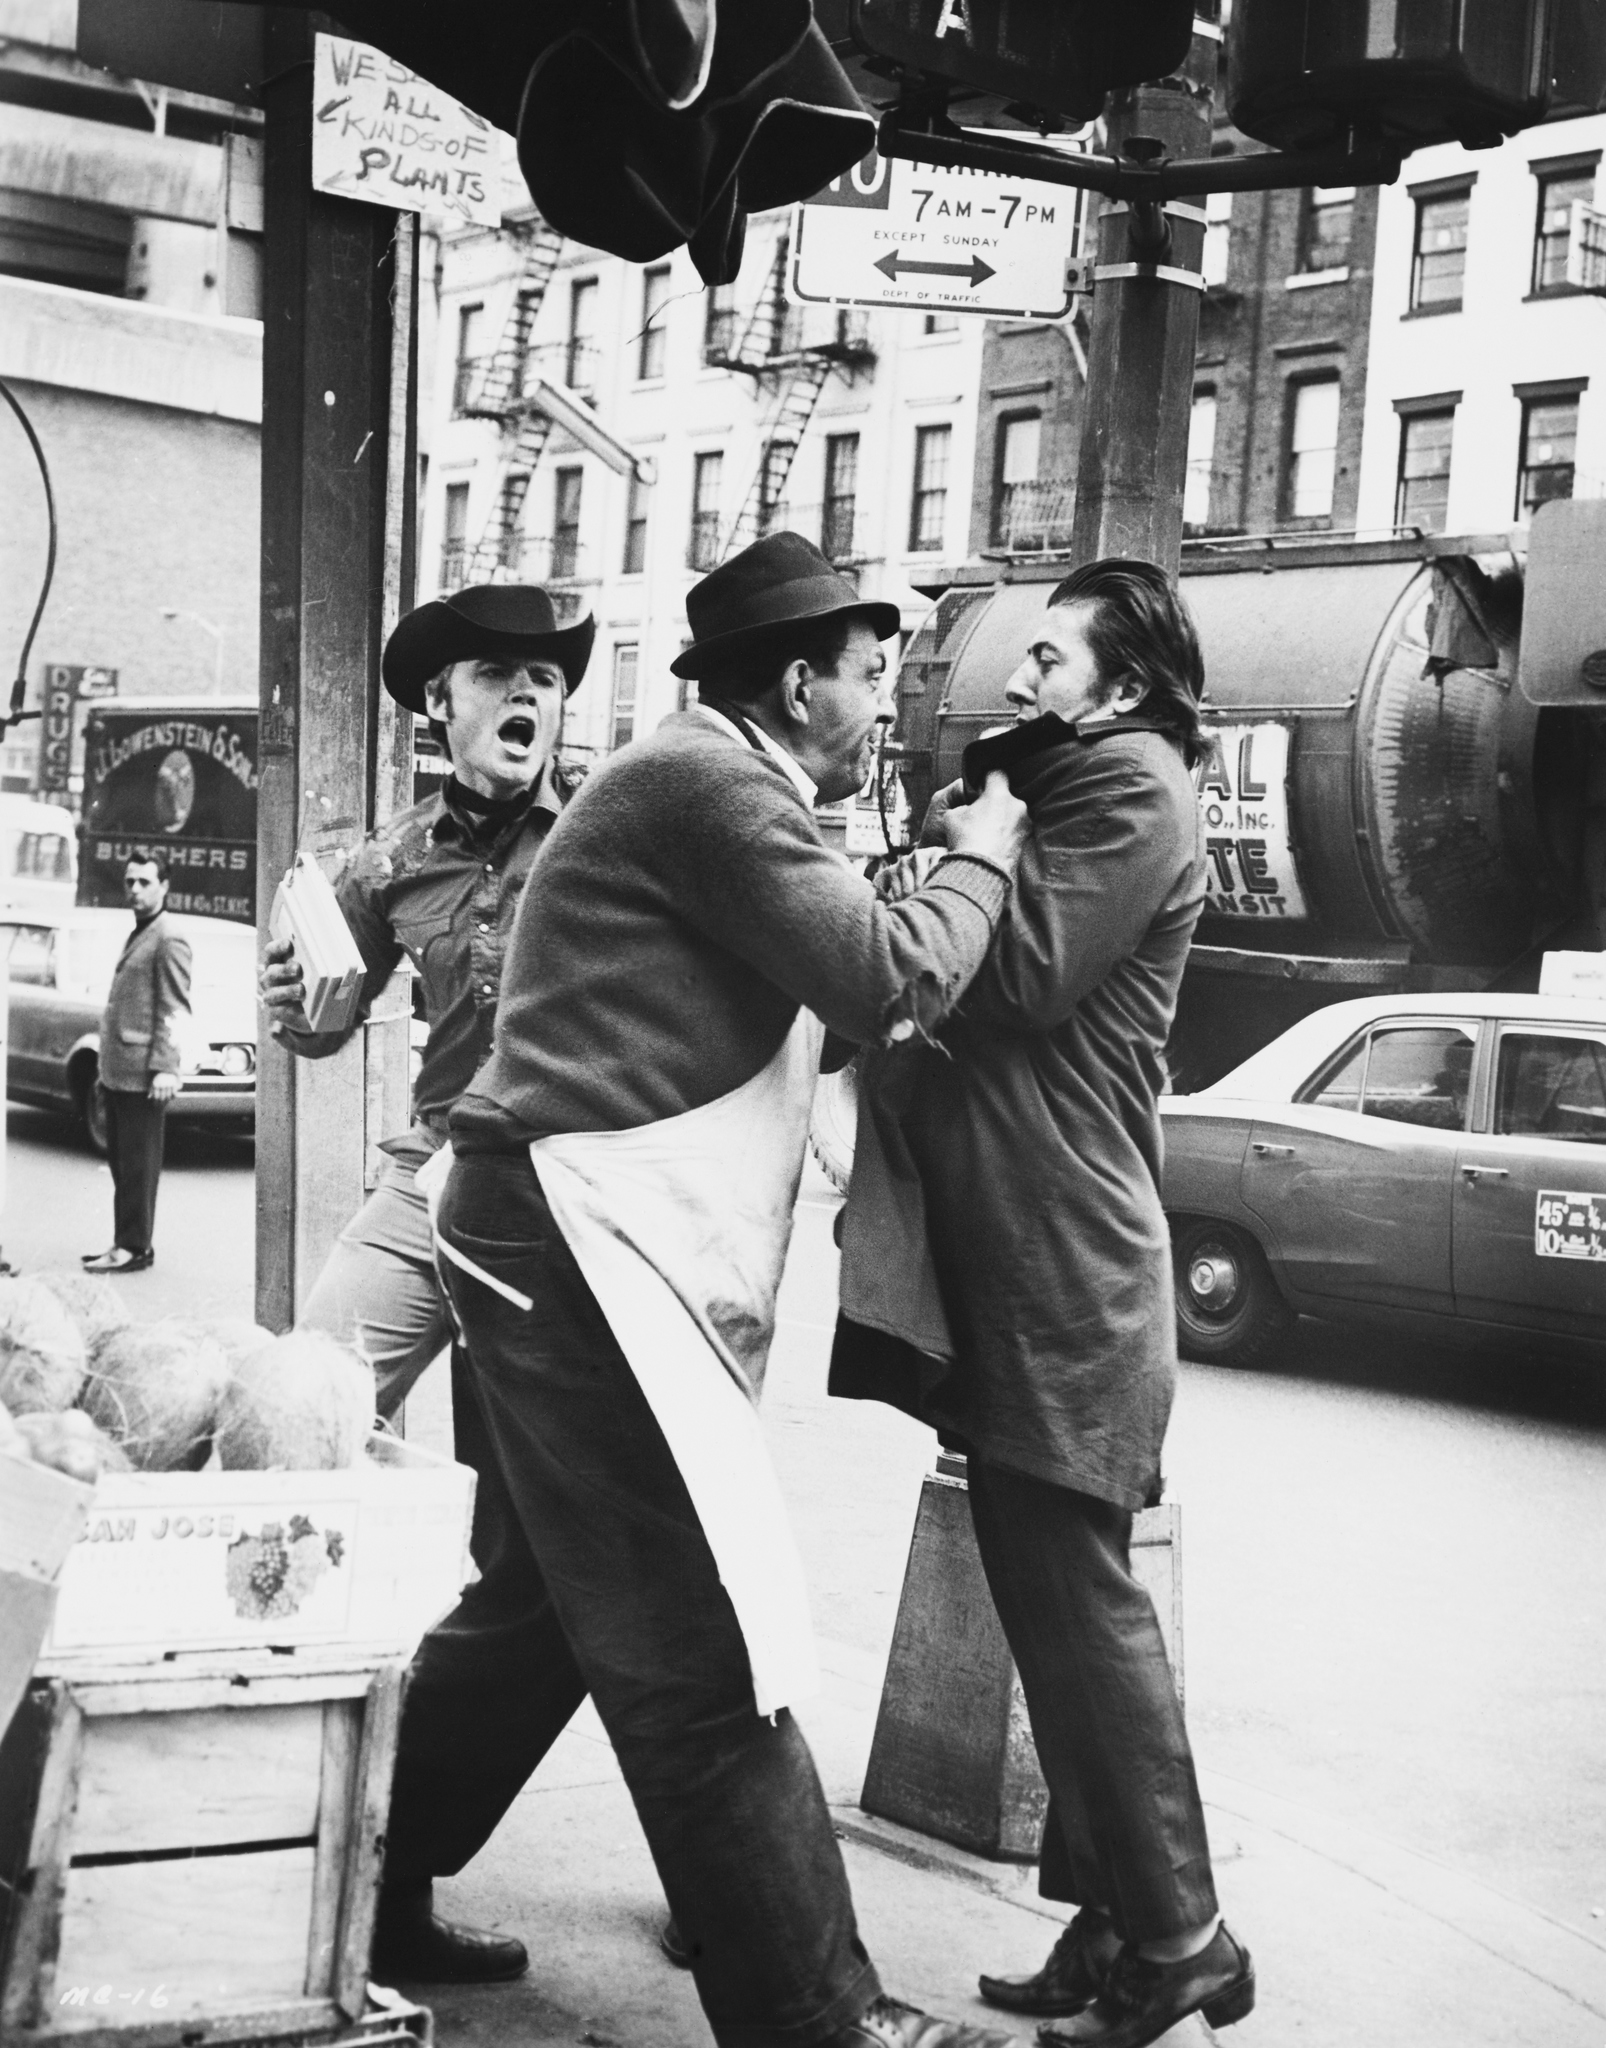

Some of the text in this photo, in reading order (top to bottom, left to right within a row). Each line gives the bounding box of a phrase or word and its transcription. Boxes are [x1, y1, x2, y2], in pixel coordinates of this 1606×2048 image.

[331, 41, 377, 86] WE
[383, 87, 441, 122] ALL
[341, 112, 488, 160] KINDS OF
[355, 147, 486, 203] PLANTS
[874, 230, 1000, 248] EXCEPT SUNDAY
[883, 289, 982, 304] DEPT OF TRAFFIC
[47, 666, 71, 789] DRUGS
[1196, 732, 1267, 801] AL
[1206, 837, 1279, 894] TE
[1204, 893, 1287, 915] ANSIT
[151, 1514, 235, 1541] JOSE
